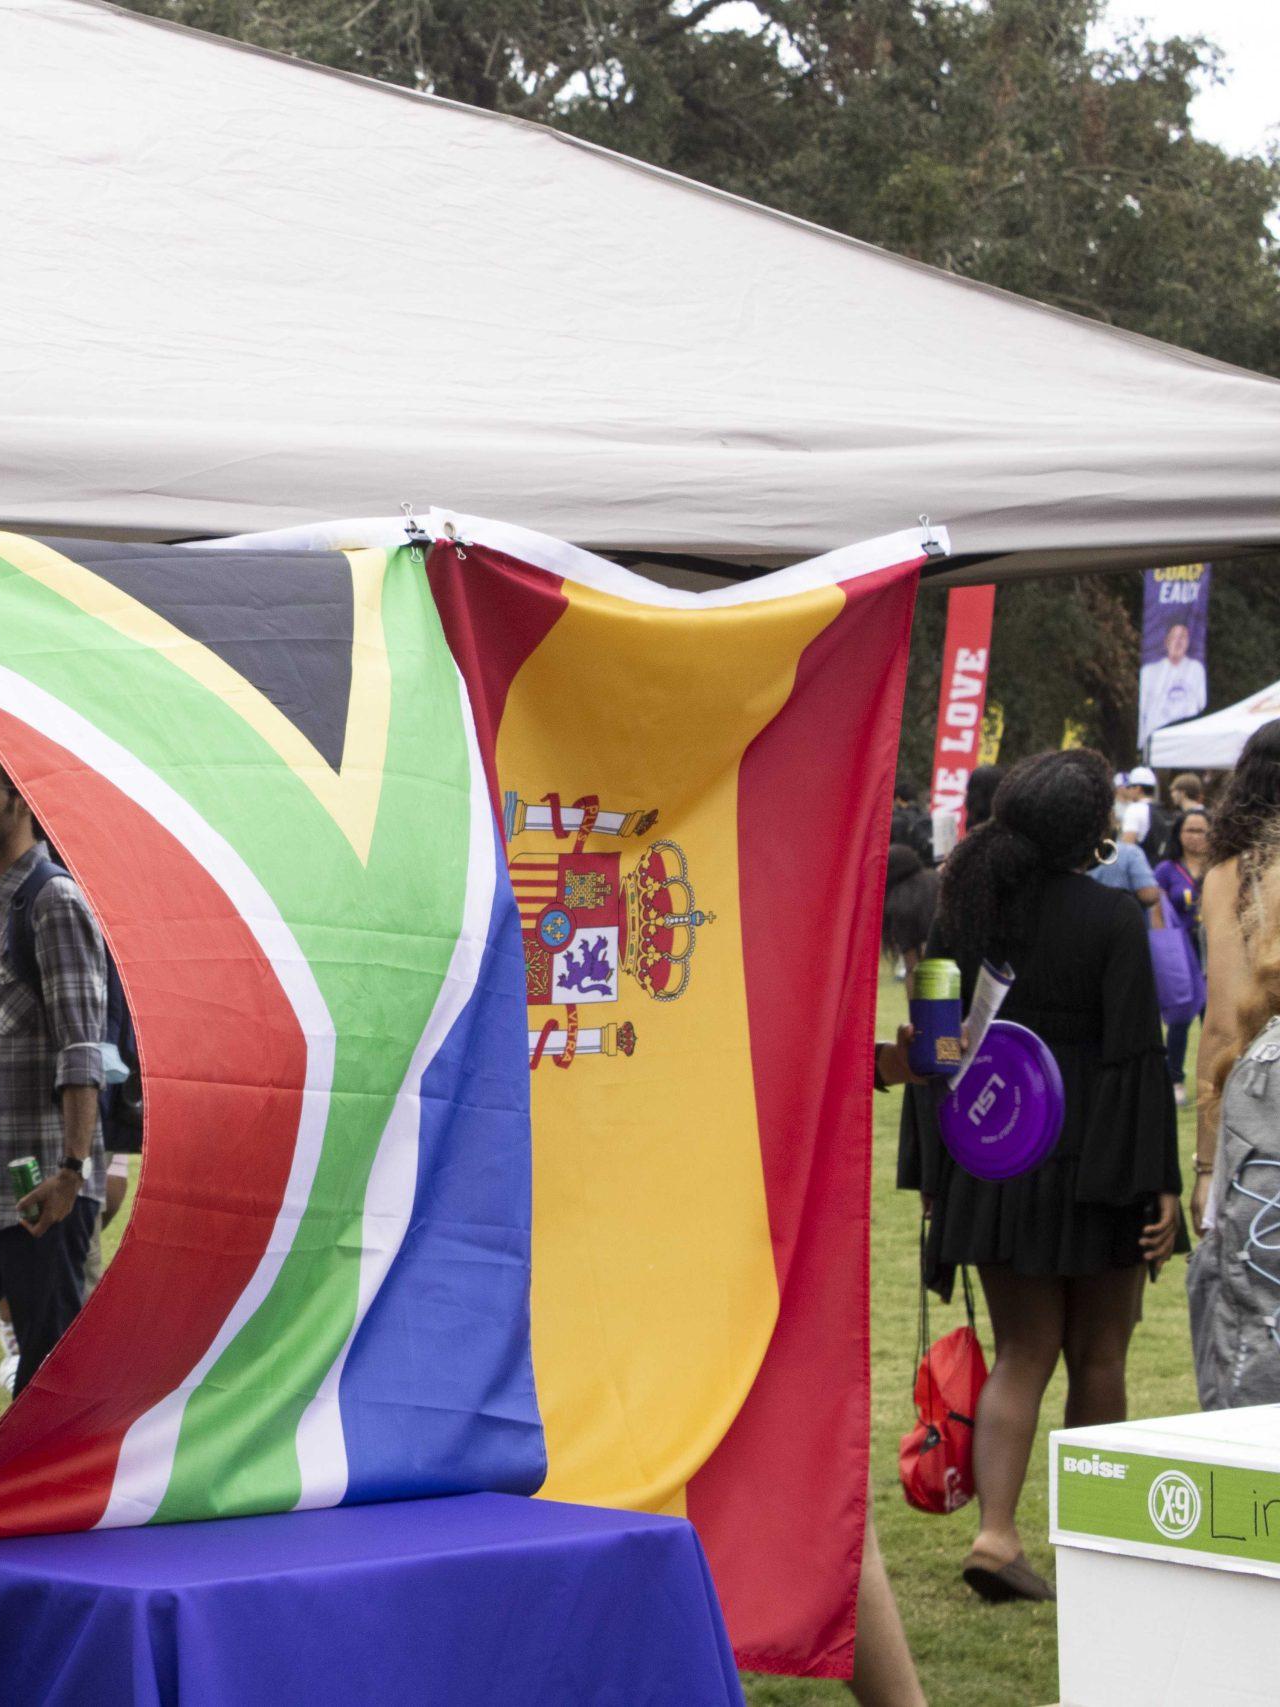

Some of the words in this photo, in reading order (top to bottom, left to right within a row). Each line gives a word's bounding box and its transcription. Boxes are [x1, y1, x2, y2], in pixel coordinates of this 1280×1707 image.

[940, 648, 987, 753] LOVE
[932, 767, 969, 823] NE
[577, 804, 599, 842] PLVS
[561, 1011, 578, 1062] VLTRA
[967, 1073, 1006, 1126] LSU
